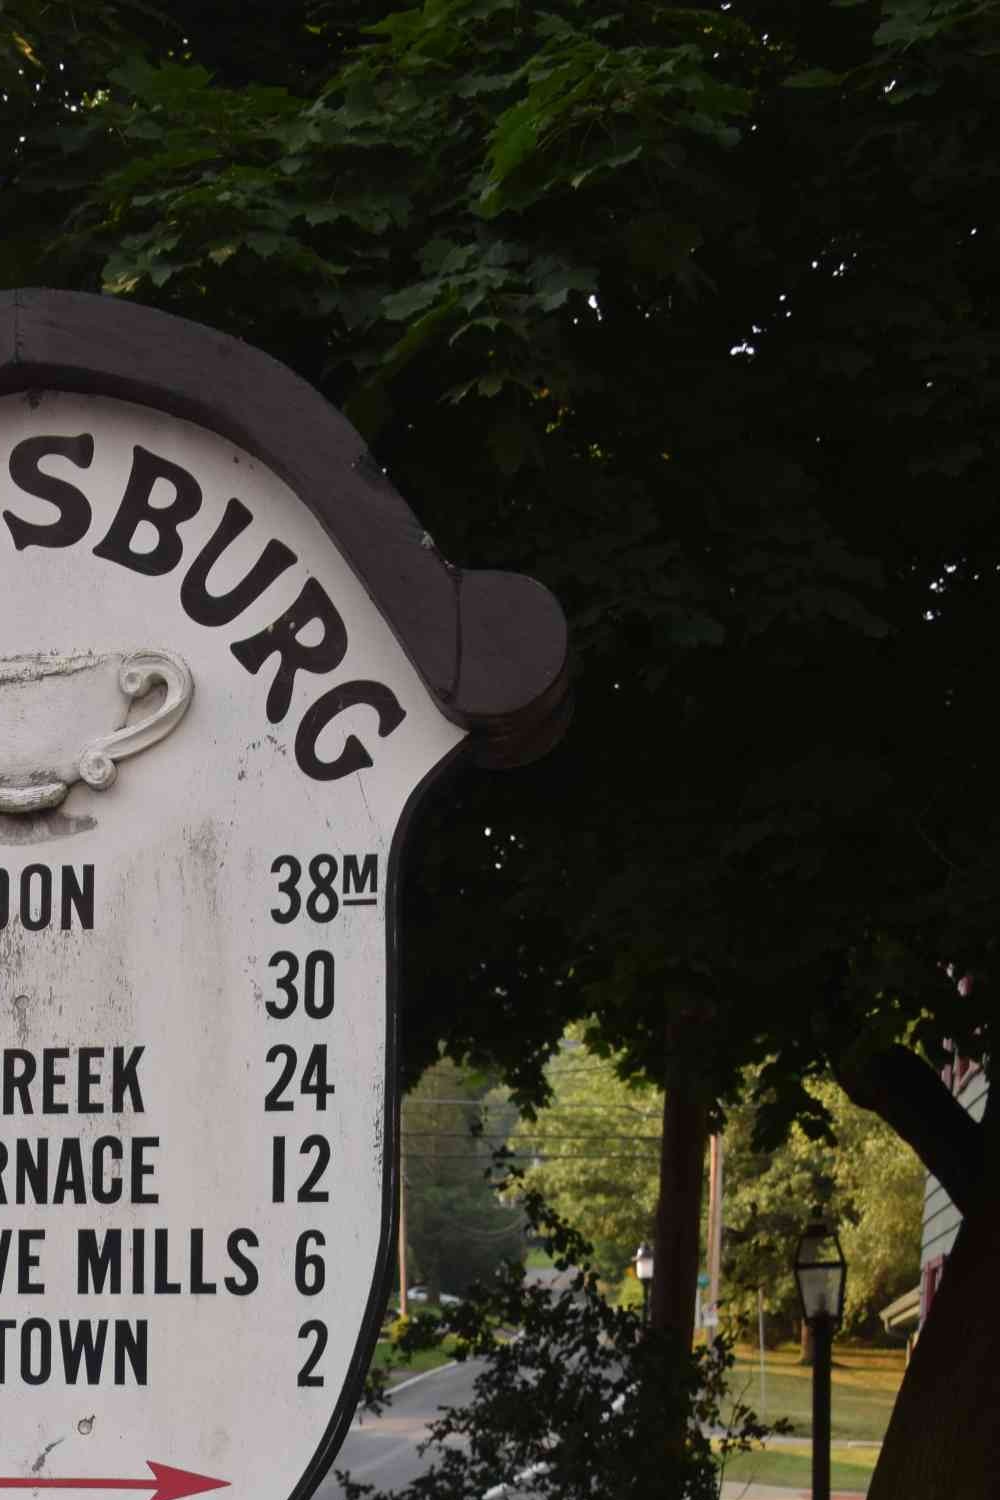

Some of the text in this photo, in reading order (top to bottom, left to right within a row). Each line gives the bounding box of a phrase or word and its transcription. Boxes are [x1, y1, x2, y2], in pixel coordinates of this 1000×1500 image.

[265, 949, 335, 1020] 30
[264, 1044, 335, 1112] 24
[272, 1134, 331, 1203] 12
[77, 1228, 259, 1296] MILLS
[294, 1229, 326, 1296] 6
[297, 1319, 328, 1387] 2
